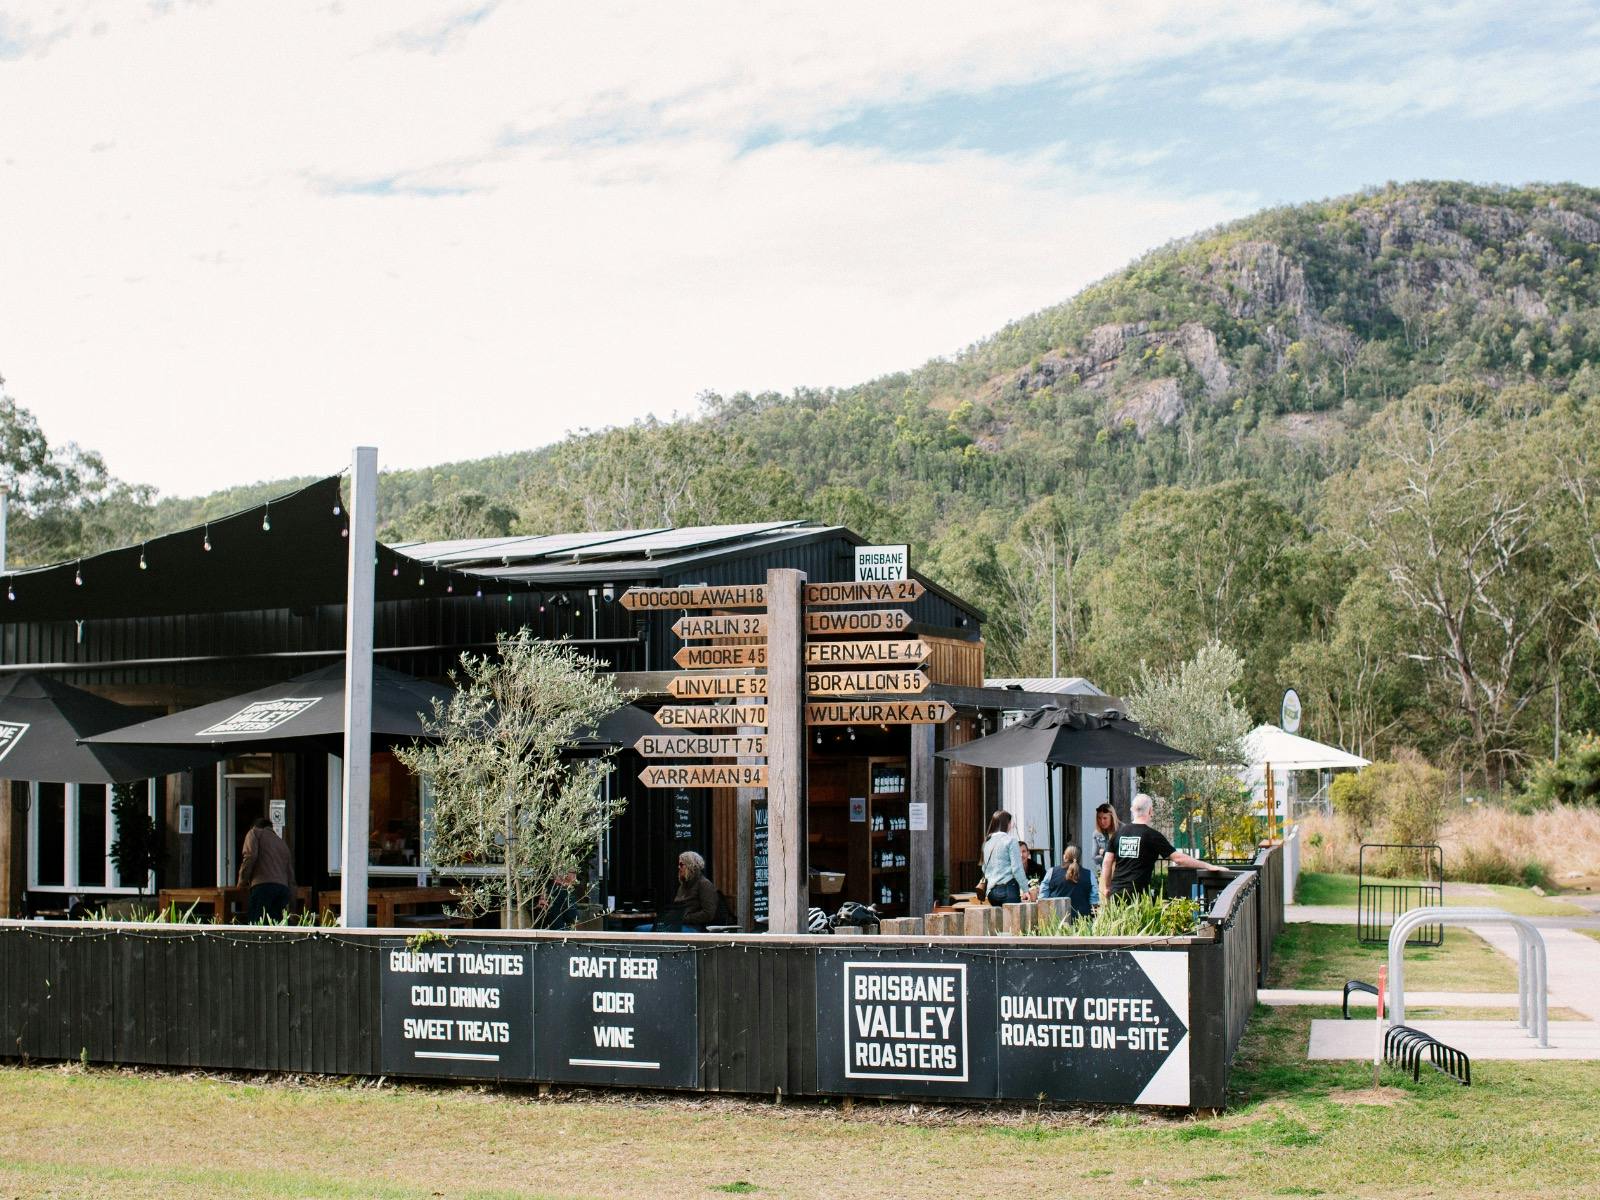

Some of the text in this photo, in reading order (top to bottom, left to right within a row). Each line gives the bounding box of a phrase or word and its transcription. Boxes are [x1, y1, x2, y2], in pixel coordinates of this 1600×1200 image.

[859, 553, 904, 565] BRISBANE
[859, 566, 903, 580] VALLEY
[628, 587, 764, 608] TOOGOOLAWAH 18
[808, 583, 917, 602] COOMINYA 24
[680, 618, 760, 636] HARLIN 32
[810, 612, 904, 631] LOWOOD 36
[688, 648, 765, 665] MOORE 45
[808, 643, 923, 661] FERNVALE 44
[676, 678, 767, 695] LINVILLE 52
[808, 673, 921, 691] BORALLON 55
[662, 707, 765, 725] BENARKIN 70
[809, 704, 945, 722] WULKURAKA 67
[643, 738, 763, 755] BLACKBUTT 75
[648, 768, 761, 785] YARRAMAN 94
[389, 950, 524, 976] GOURMET TOASTIES
[569, 956, 658, 980] CRAFT BEER
[411, 985, 500, 1009] COLD DRINKS
[854, 975, 955, 1002] BRISBANE
[592, 991, 635, 1014] CIDER
[1000, 995, 1160, 1025] QUALITY COFFEE,
[404, 1018, 510, 1043] SWEET TREATS
[855, 1004, 955, 1040] VALLEY
[593, 1025, 635, 1049] WINE
[1000, 1023, 1170, 1052] ROASTED ON-SITE
[855, 1042, 957, 1069] ROASTERS
